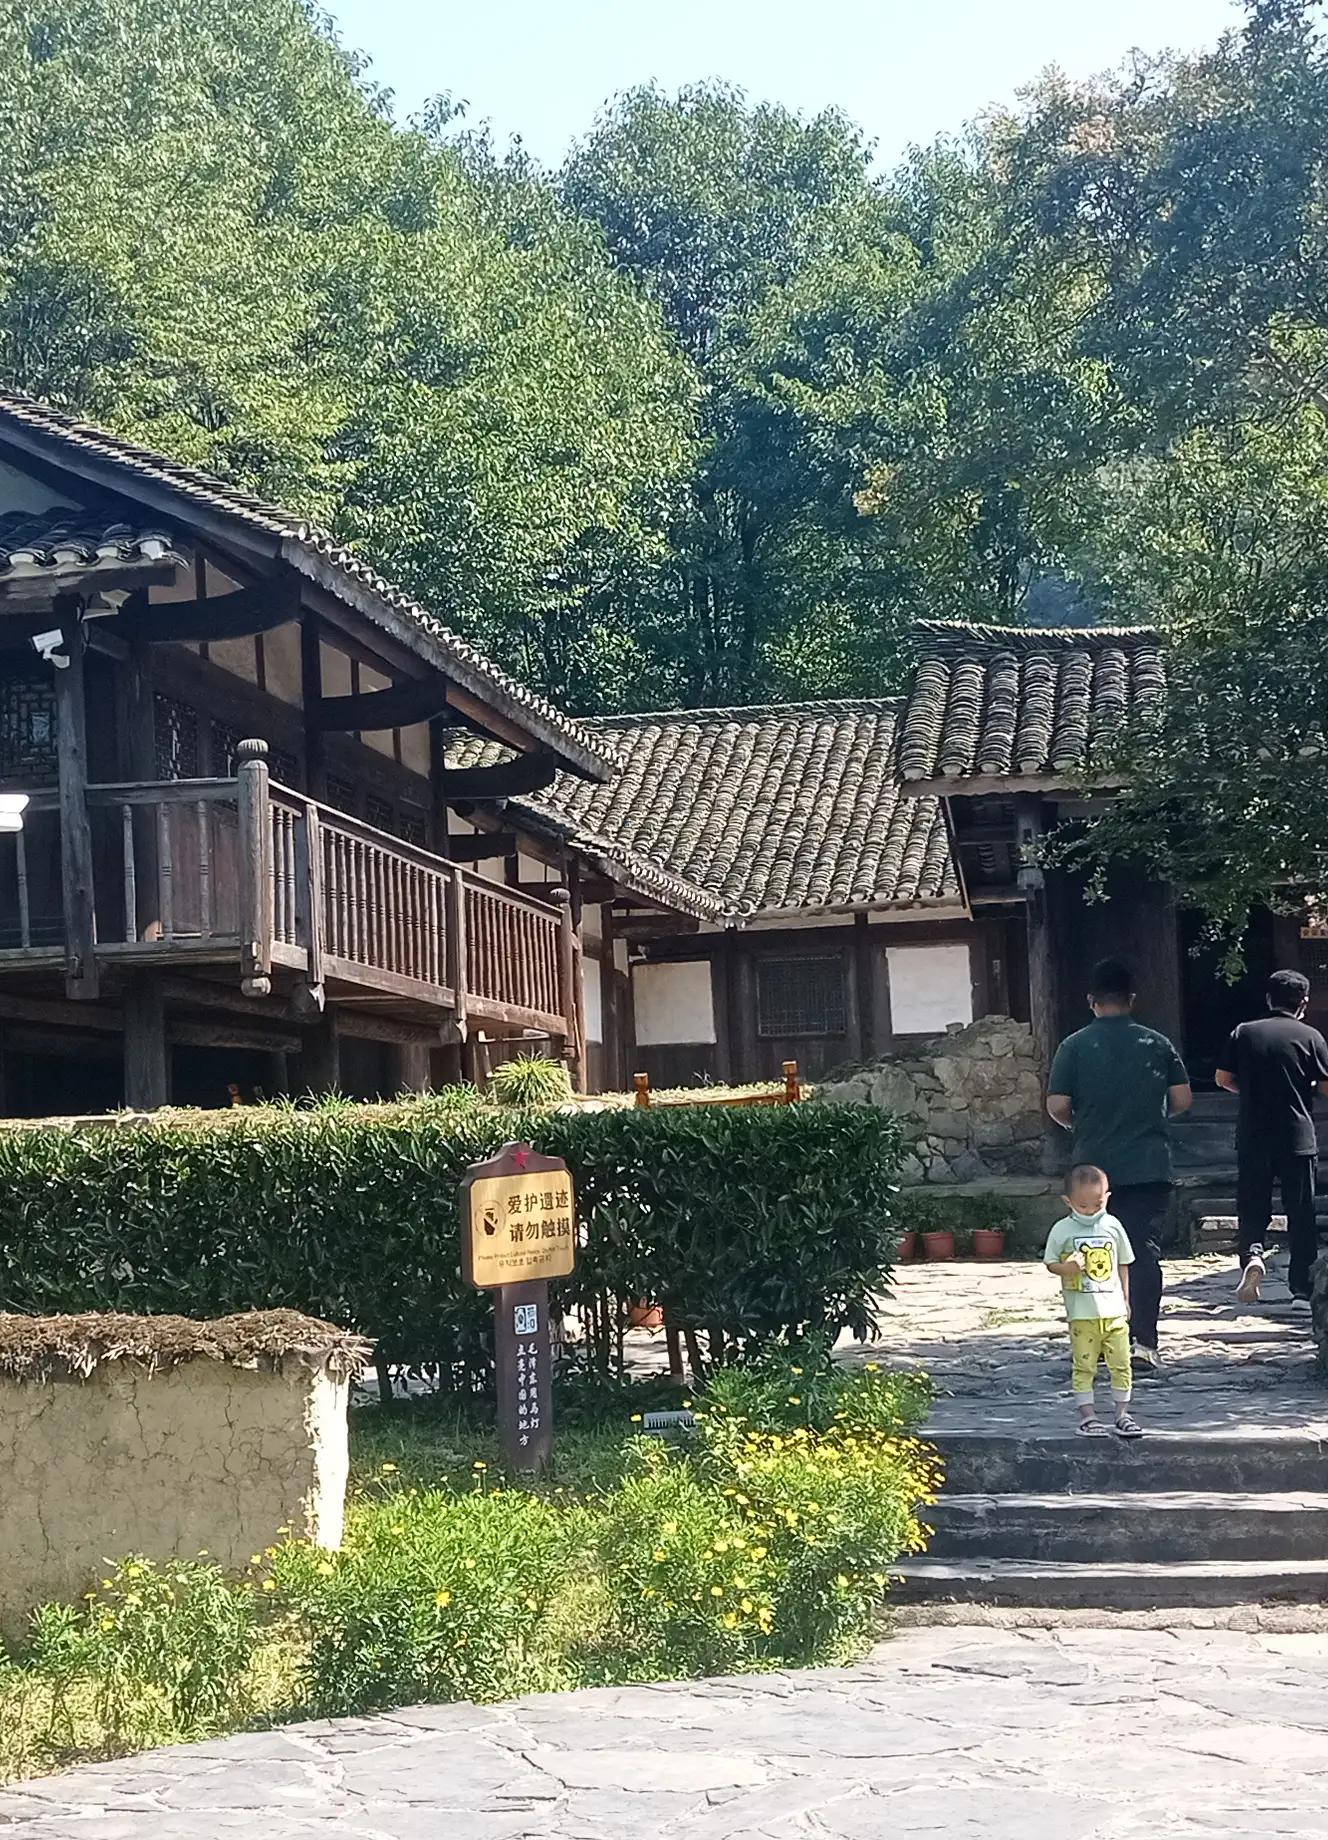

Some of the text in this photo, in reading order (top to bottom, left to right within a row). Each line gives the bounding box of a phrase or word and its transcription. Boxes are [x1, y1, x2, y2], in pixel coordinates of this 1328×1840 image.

[508, 1189, 569, 1215] 爱护遗迹
[509, 1217, 571, 1243] 请勿触摸
